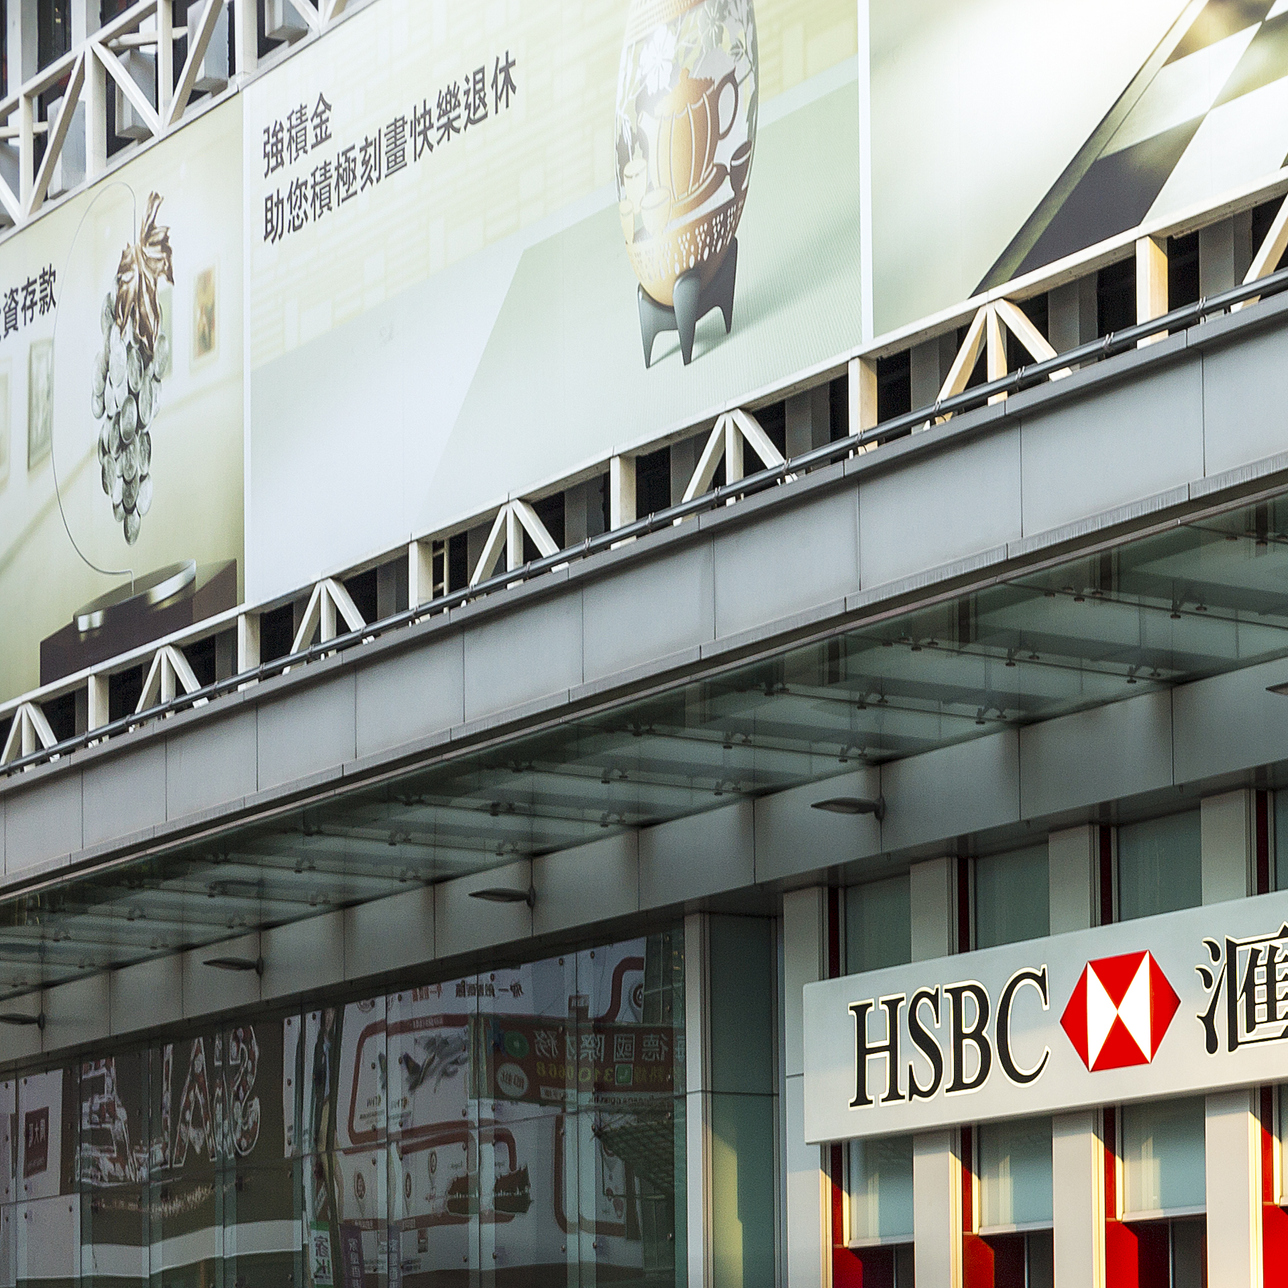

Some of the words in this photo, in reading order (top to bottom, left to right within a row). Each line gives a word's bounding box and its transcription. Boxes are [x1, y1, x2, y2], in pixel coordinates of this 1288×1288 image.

[263, 92, 332, 179] 強積金
[264, 50, 517, 245] 助您積極刻畫快樂退休
[0, 263, 56, 339] 資存款
[848, 965, 1051, 1108] HSBC
